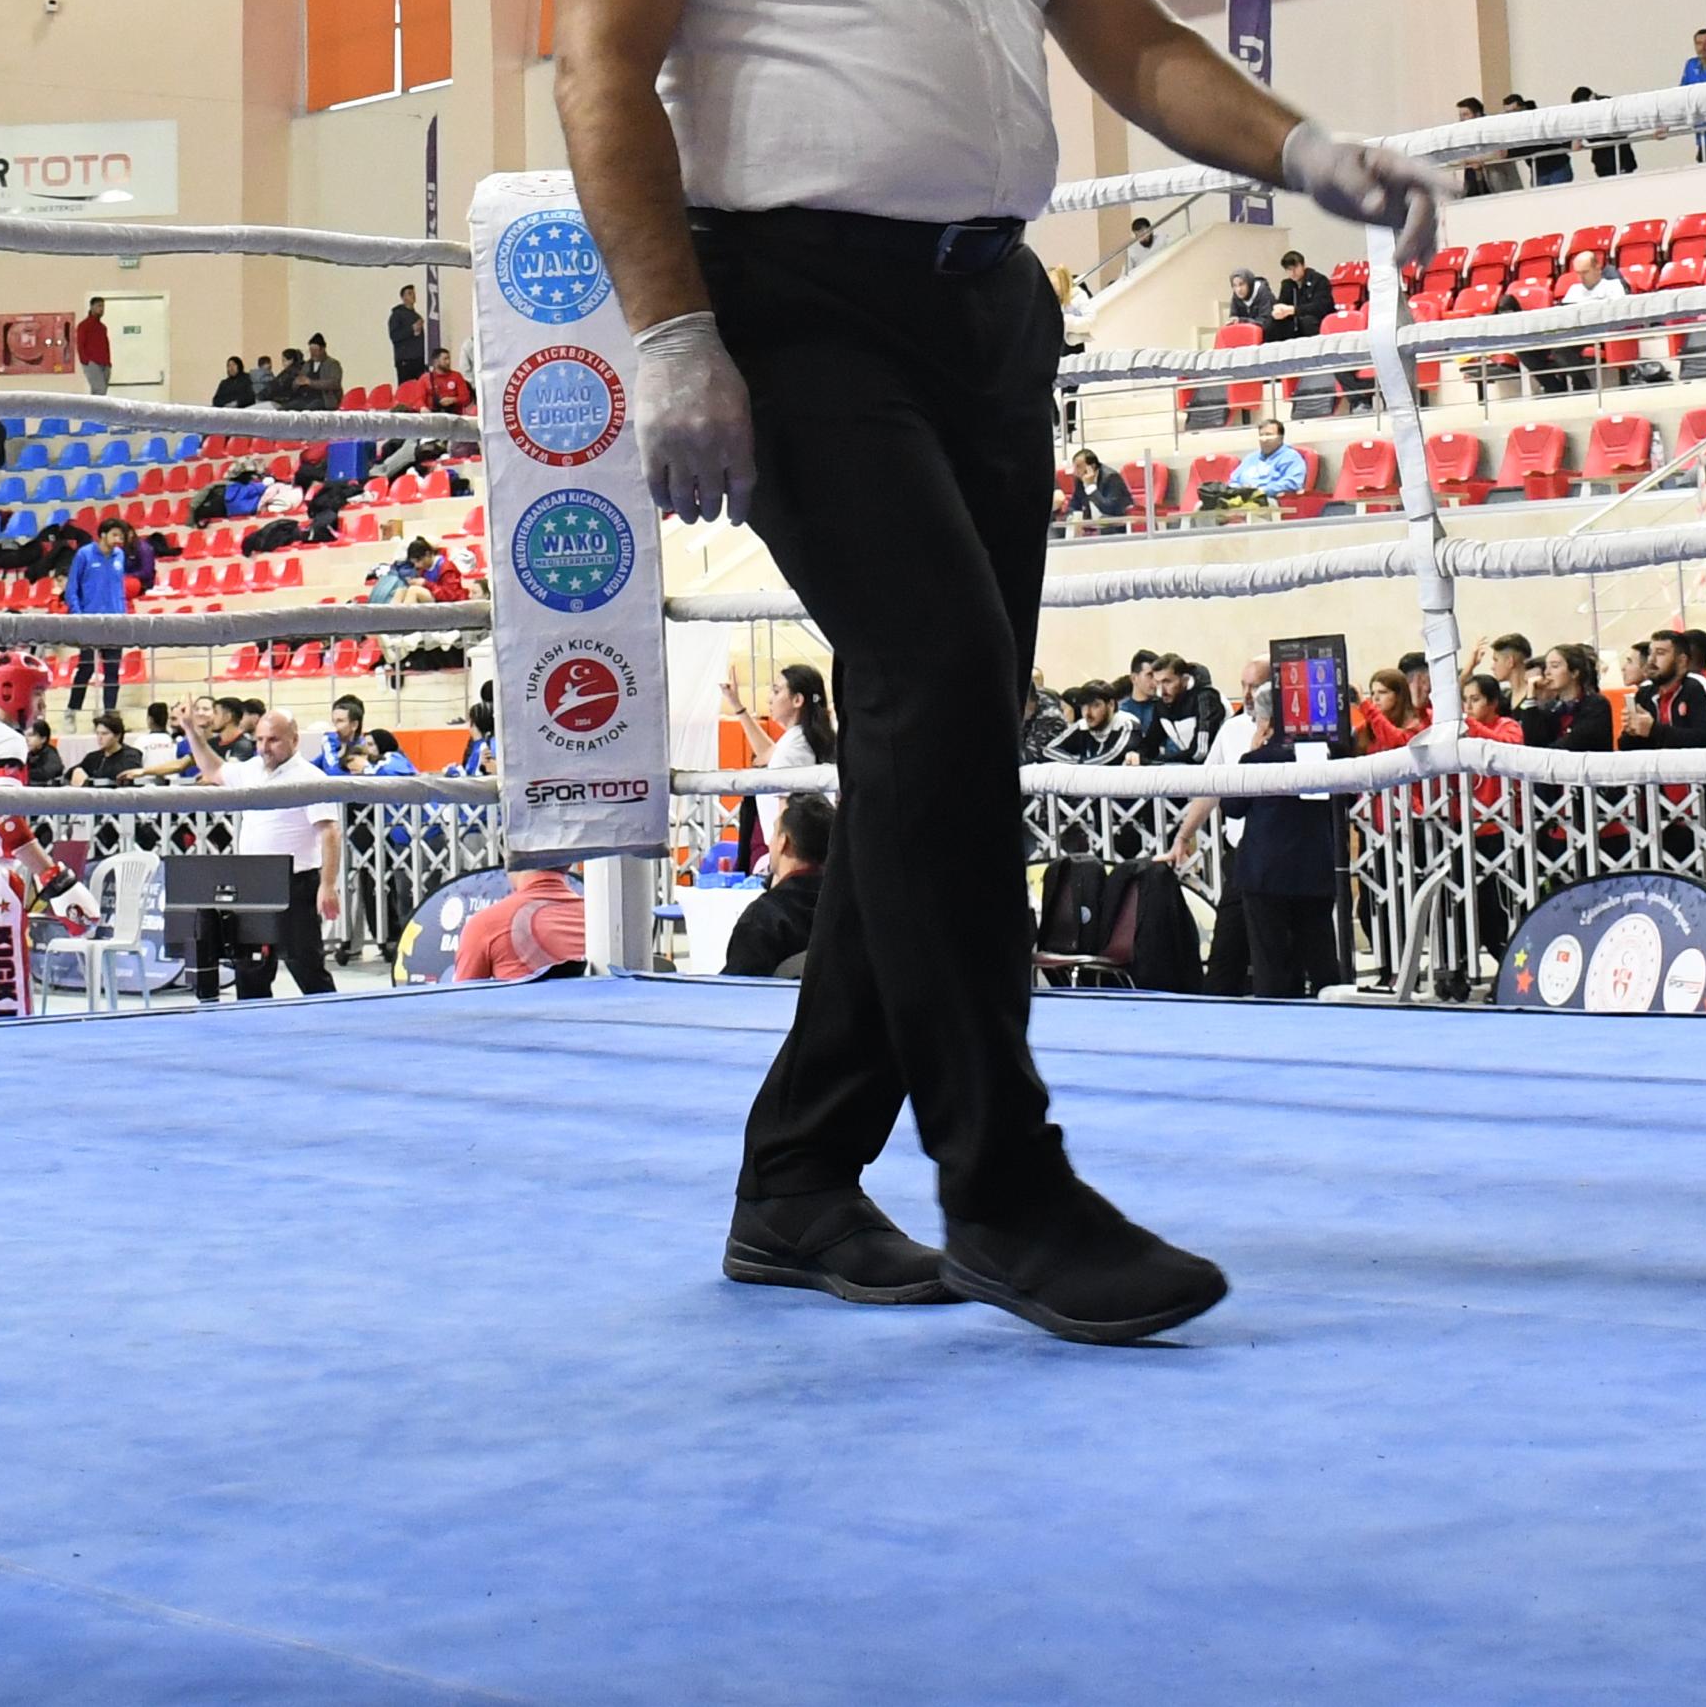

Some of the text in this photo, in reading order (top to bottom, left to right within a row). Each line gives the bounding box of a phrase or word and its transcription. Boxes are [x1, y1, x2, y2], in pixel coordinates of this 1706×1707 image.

[498, 220, 527, 283] ASSOCIATION
[515, 249, 598, 279] WAKO
[504, 347, 625, 463] WAKO EUROPEAN KICKBOXING FEDERATION
[536, 385, 591, 407] WAKO
[528, 406, 604, 429] EUROPE
[516, 492, 632, 600] WAKO MEDITERRANEAN KICKBOXING FEDERATION
[542, 533, 607, 556] WAKO
[526, 639, 638, 702] TURKISH KICKBOXING
[1318, 690, 1327, 717] 9
[538, 721, 629, 751] FEDERATION
